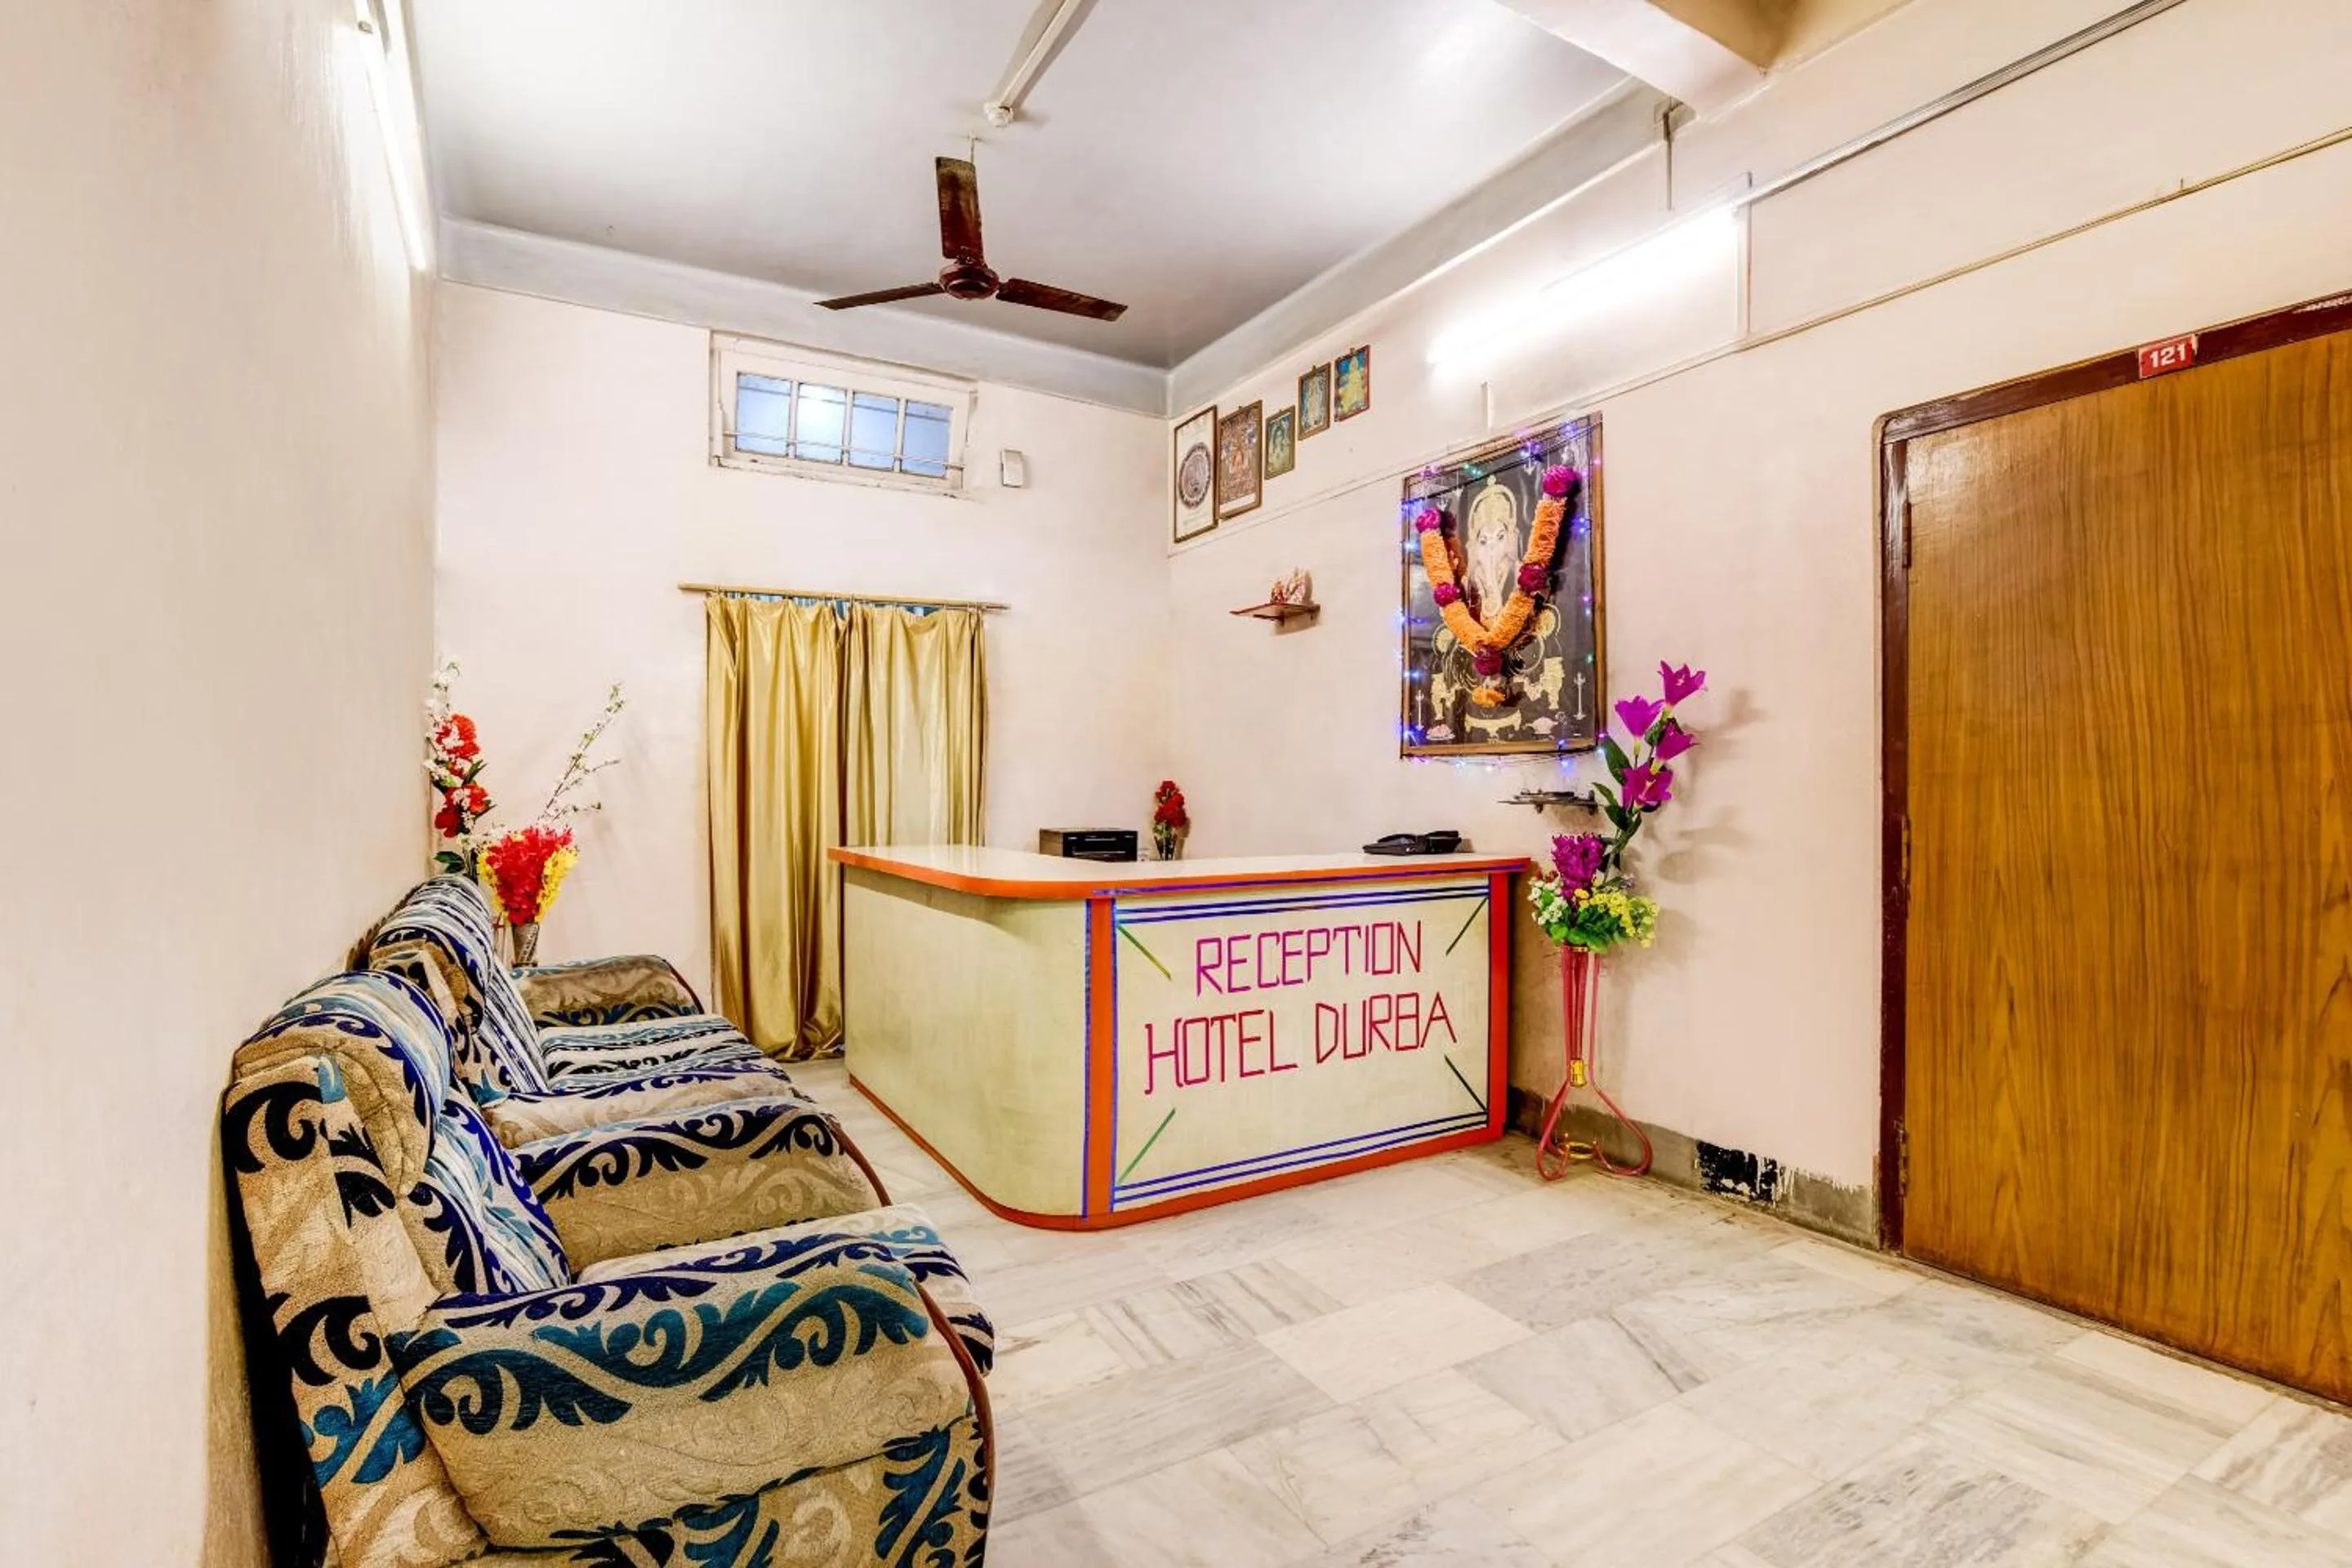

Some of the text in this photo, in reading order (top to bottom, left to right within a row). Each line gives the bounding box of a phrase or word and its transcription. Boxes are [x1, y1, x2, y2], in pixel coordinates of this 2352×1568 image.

[2149, 342, 2186, 368] 121
[1195, 920, 1422, 997] RECEPTION
[1144, 991, 1457, 1095] HOTEL DURBA
